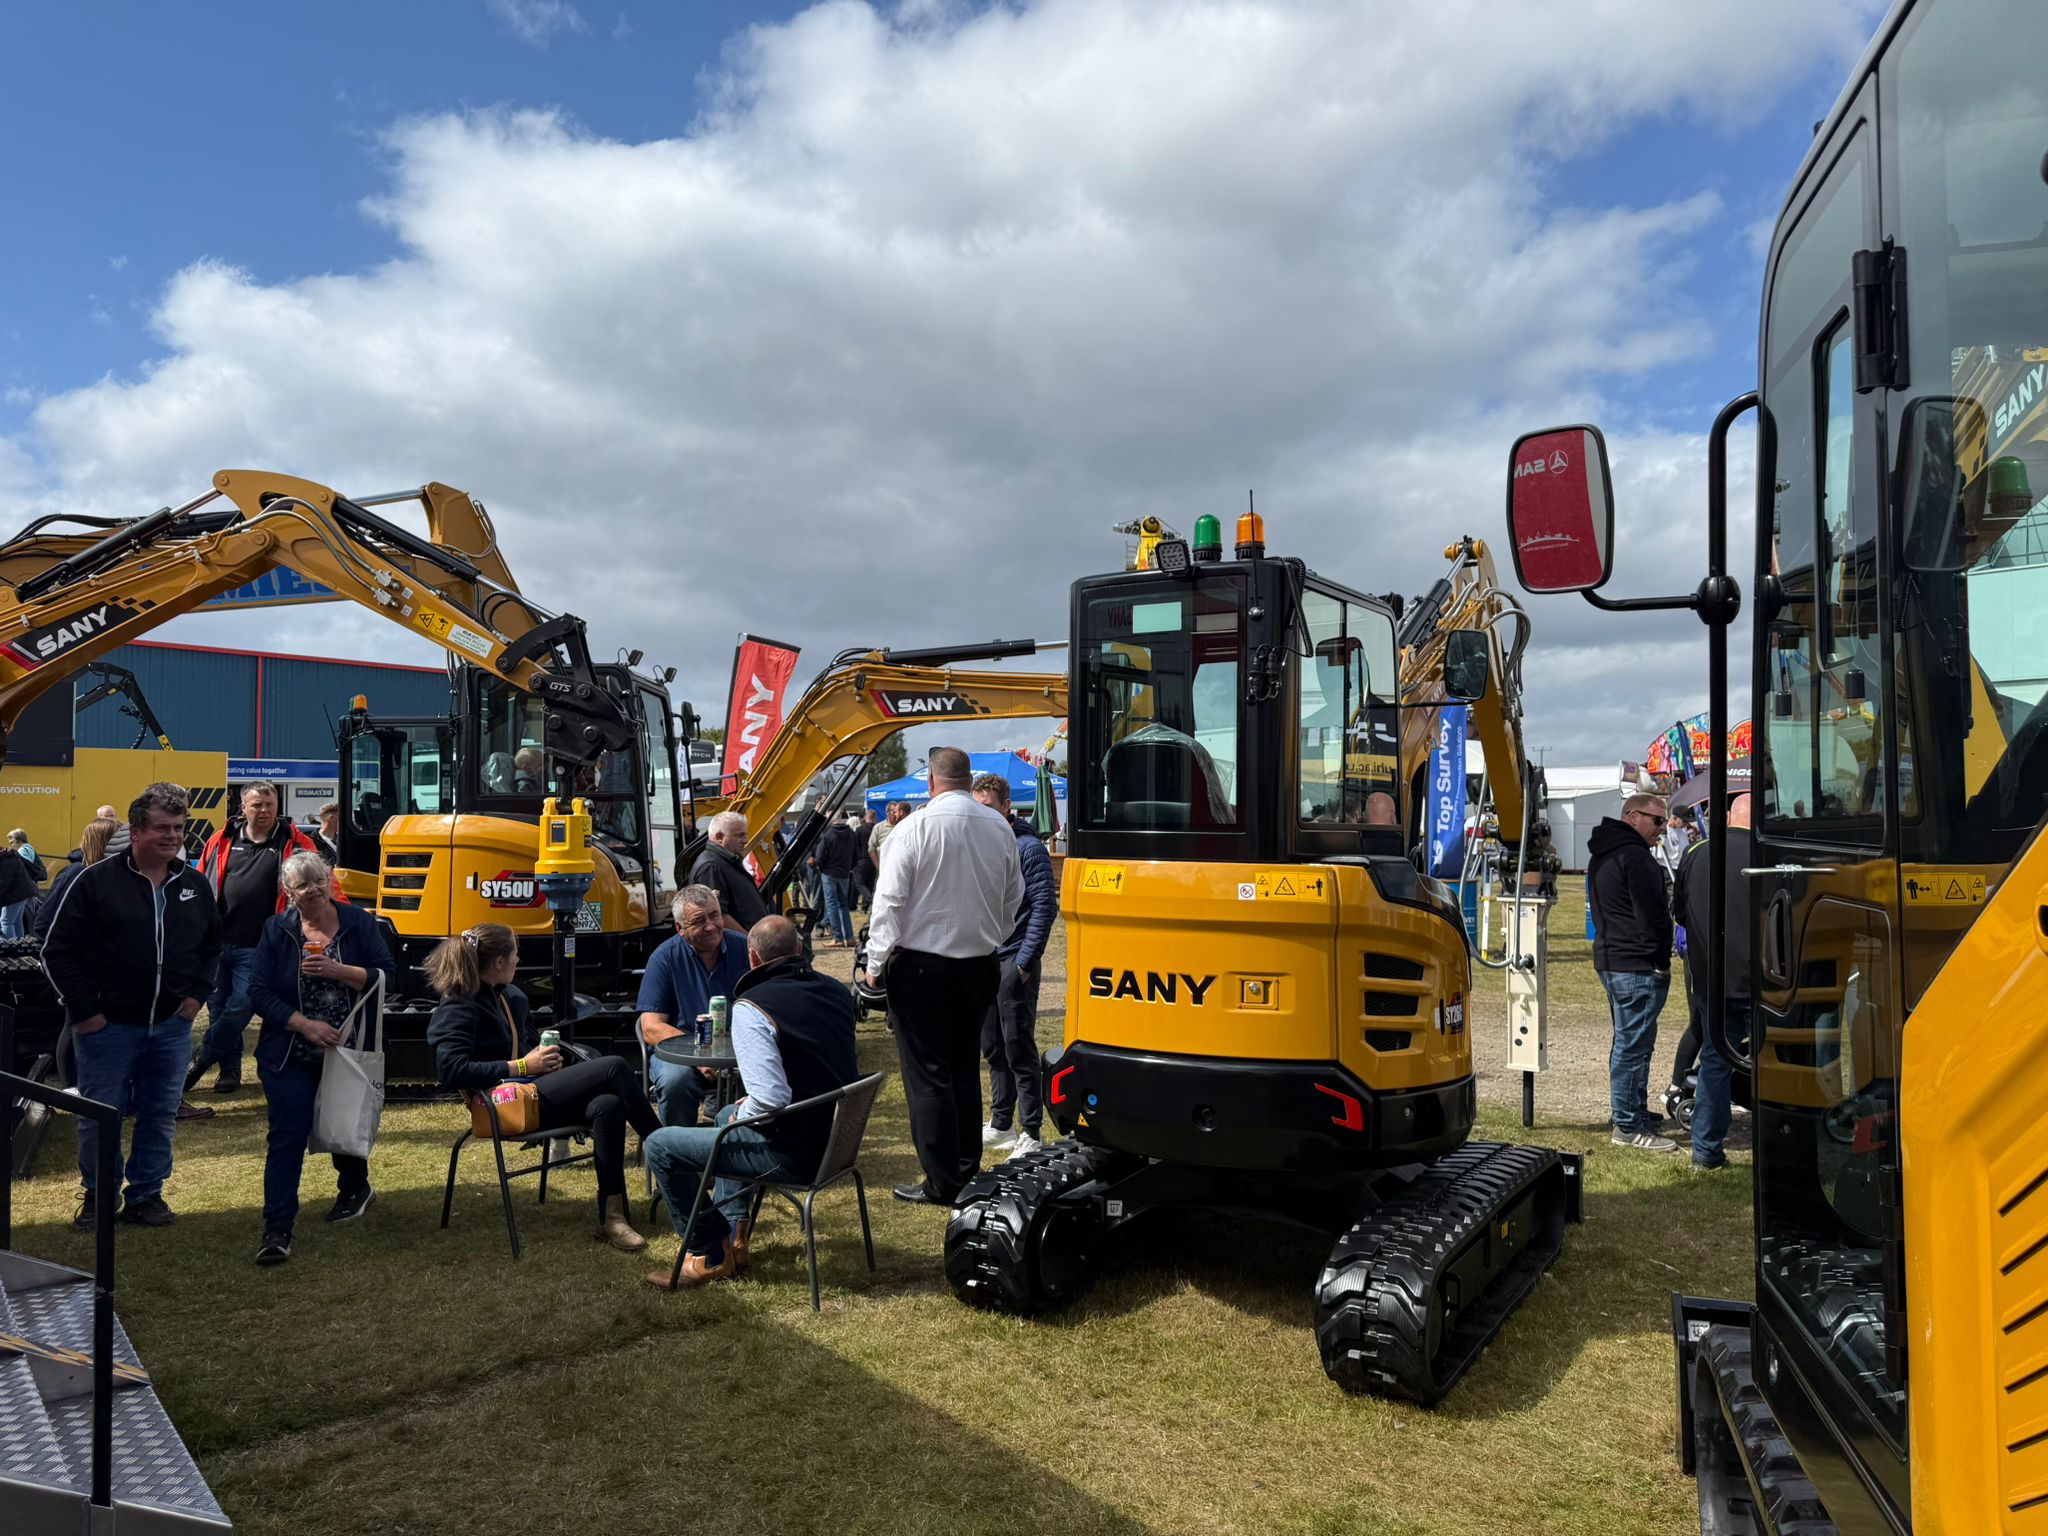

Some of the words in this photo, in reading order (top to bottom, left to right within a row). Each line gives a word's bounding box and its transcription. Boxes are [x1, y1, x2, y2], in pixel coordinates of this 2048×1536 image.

[1995, 364, 2044, 438] SANY
[36, 605, 107, 657] SANY
[550, 681, 571, 692] GTS
[897, 696, 956, 713] SANY
[739, 672, 775, 775] ANY
[261, 767, 287, 775] together
[1436, 718, 1452, 793] Survey
[1437, 796, 1453, 834] Top
[182, 888, 195, 896] NIKE
[481, 880, 534, 898] SY50U
[1089, 967, 1218, 1006] SANY
